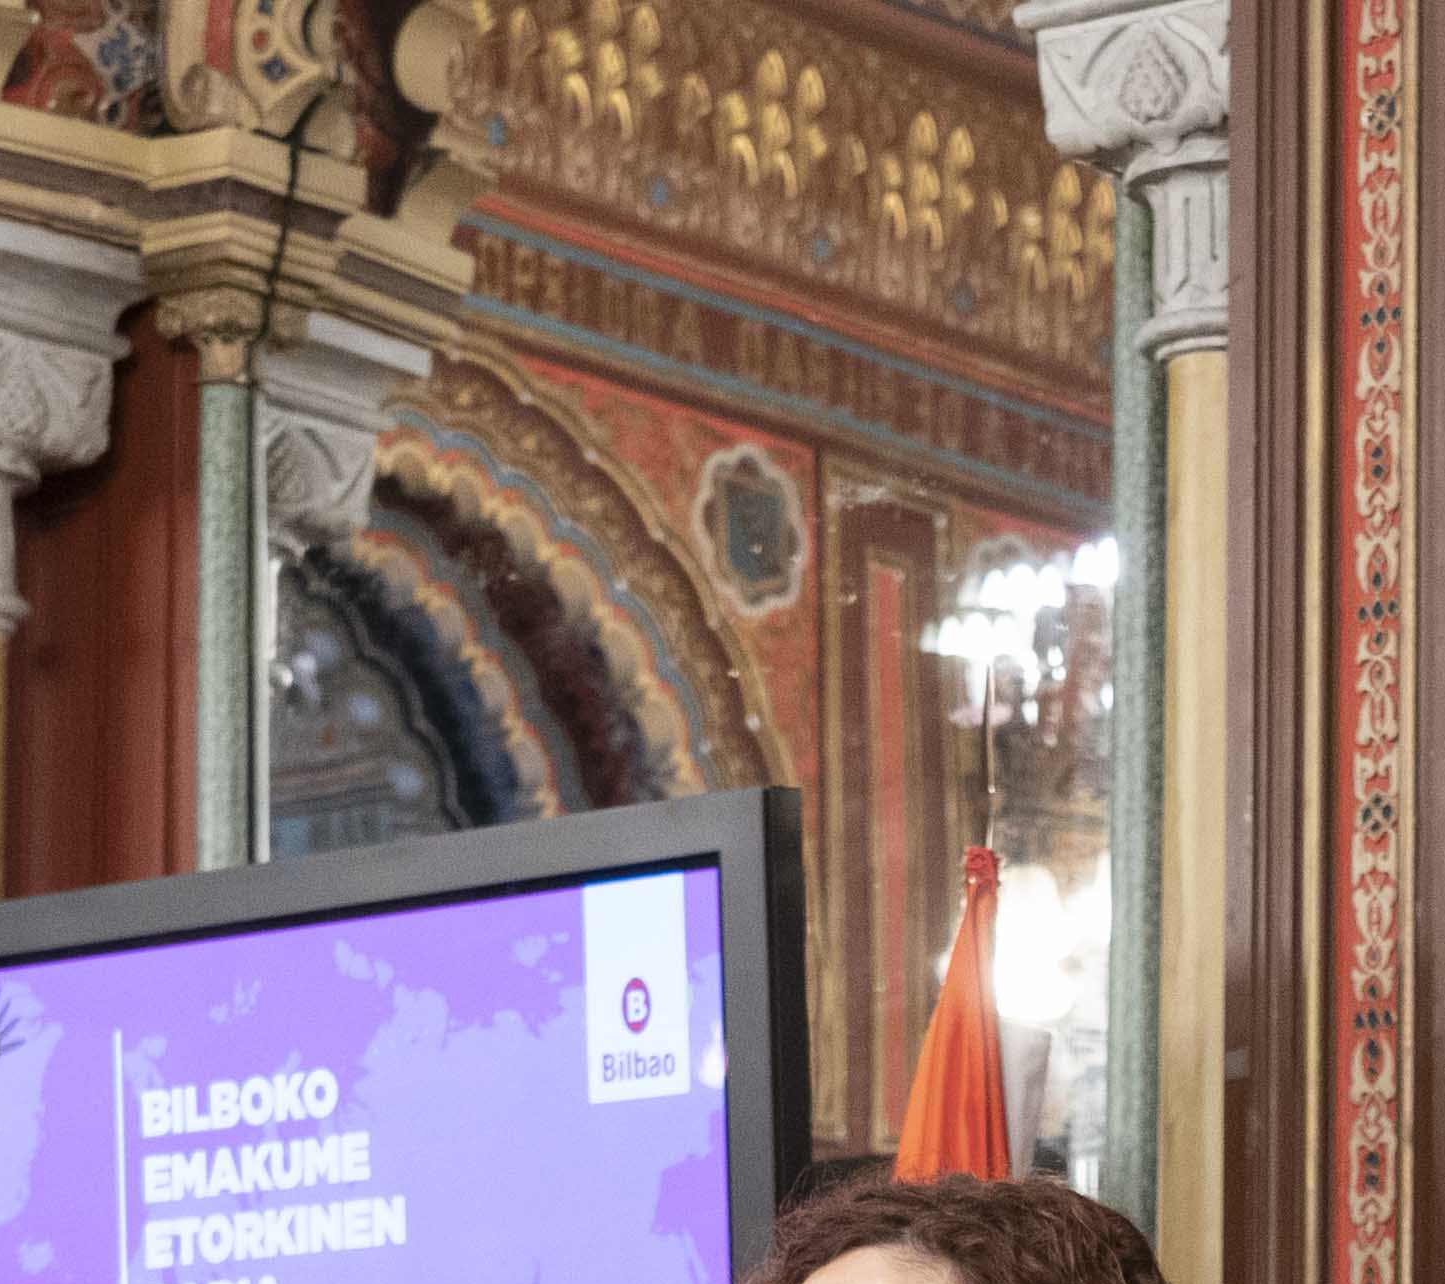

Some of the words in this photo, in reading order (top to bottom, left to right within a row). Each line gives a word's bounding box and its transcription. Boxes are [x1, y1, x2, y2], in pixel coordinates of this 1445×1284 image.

[625, 988, 648, 1024] B
[602, 1051, 676, 1083] Bilbao
[141, 1068, 339, 1139] BILBOKO
[142, 1131, 371, 1205] EMAKUME
[144, 1195, 406, 1269] ETORKINEN
